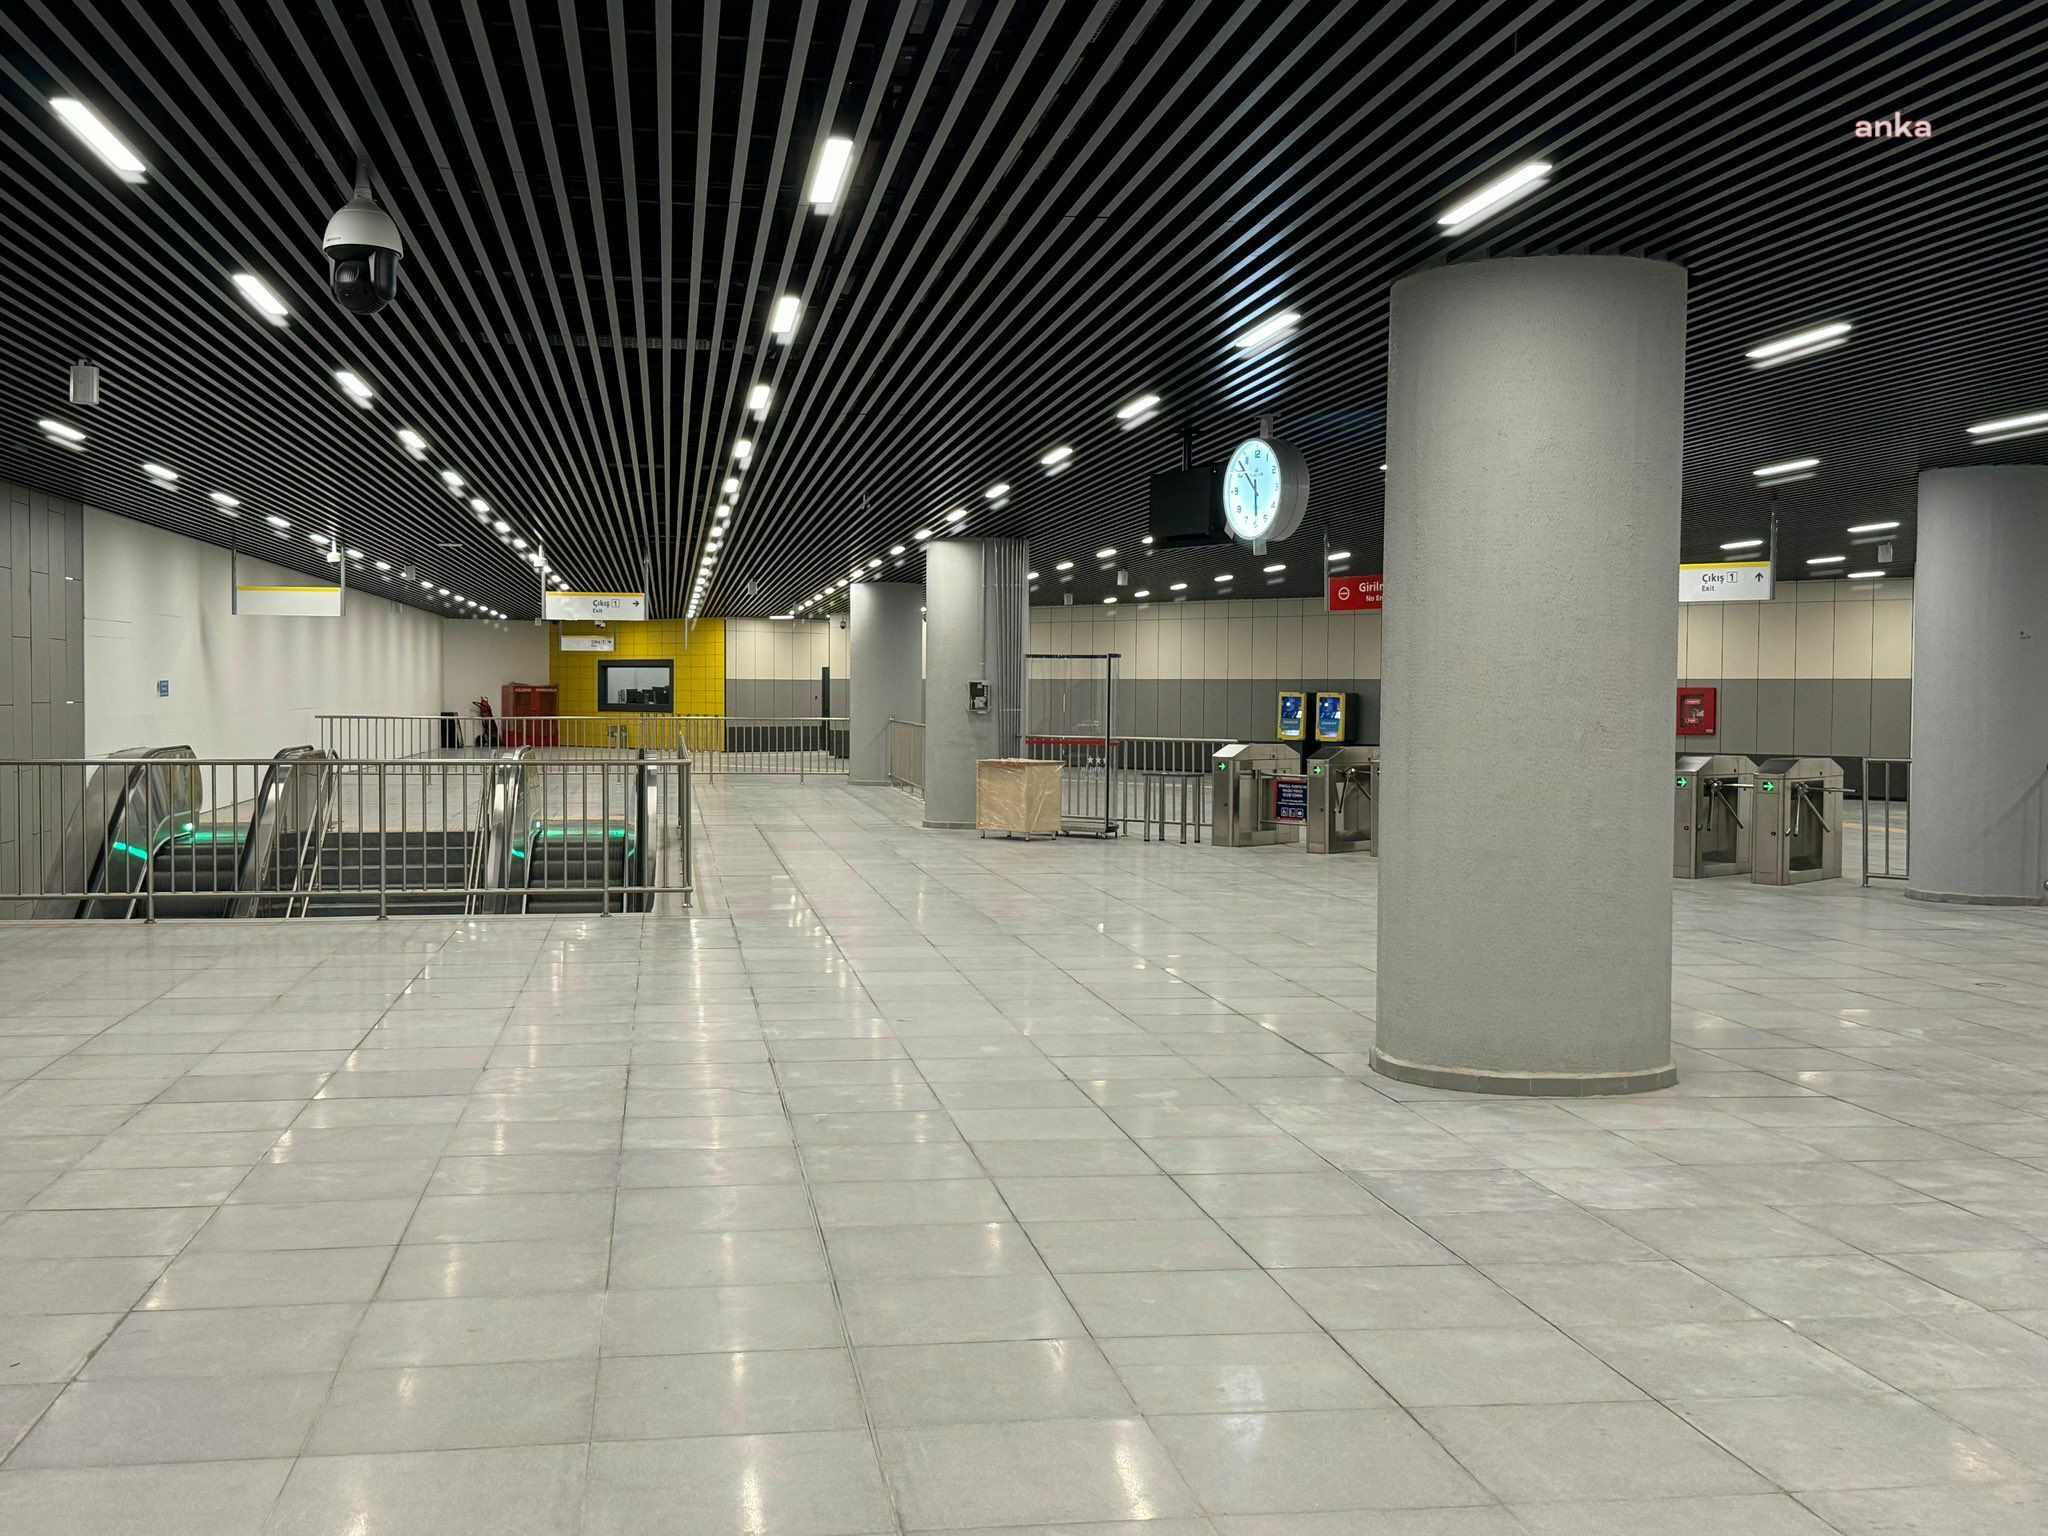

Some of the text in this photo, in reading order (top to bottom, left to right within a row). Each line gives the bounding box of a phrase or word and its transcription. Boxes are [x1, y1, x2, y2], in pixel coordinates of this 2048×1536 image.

[1254, 449, 1261, 459] 12
[1702, 573, 1725, 584] Çıkış
[592, 599, 610, 608] Çıkış
